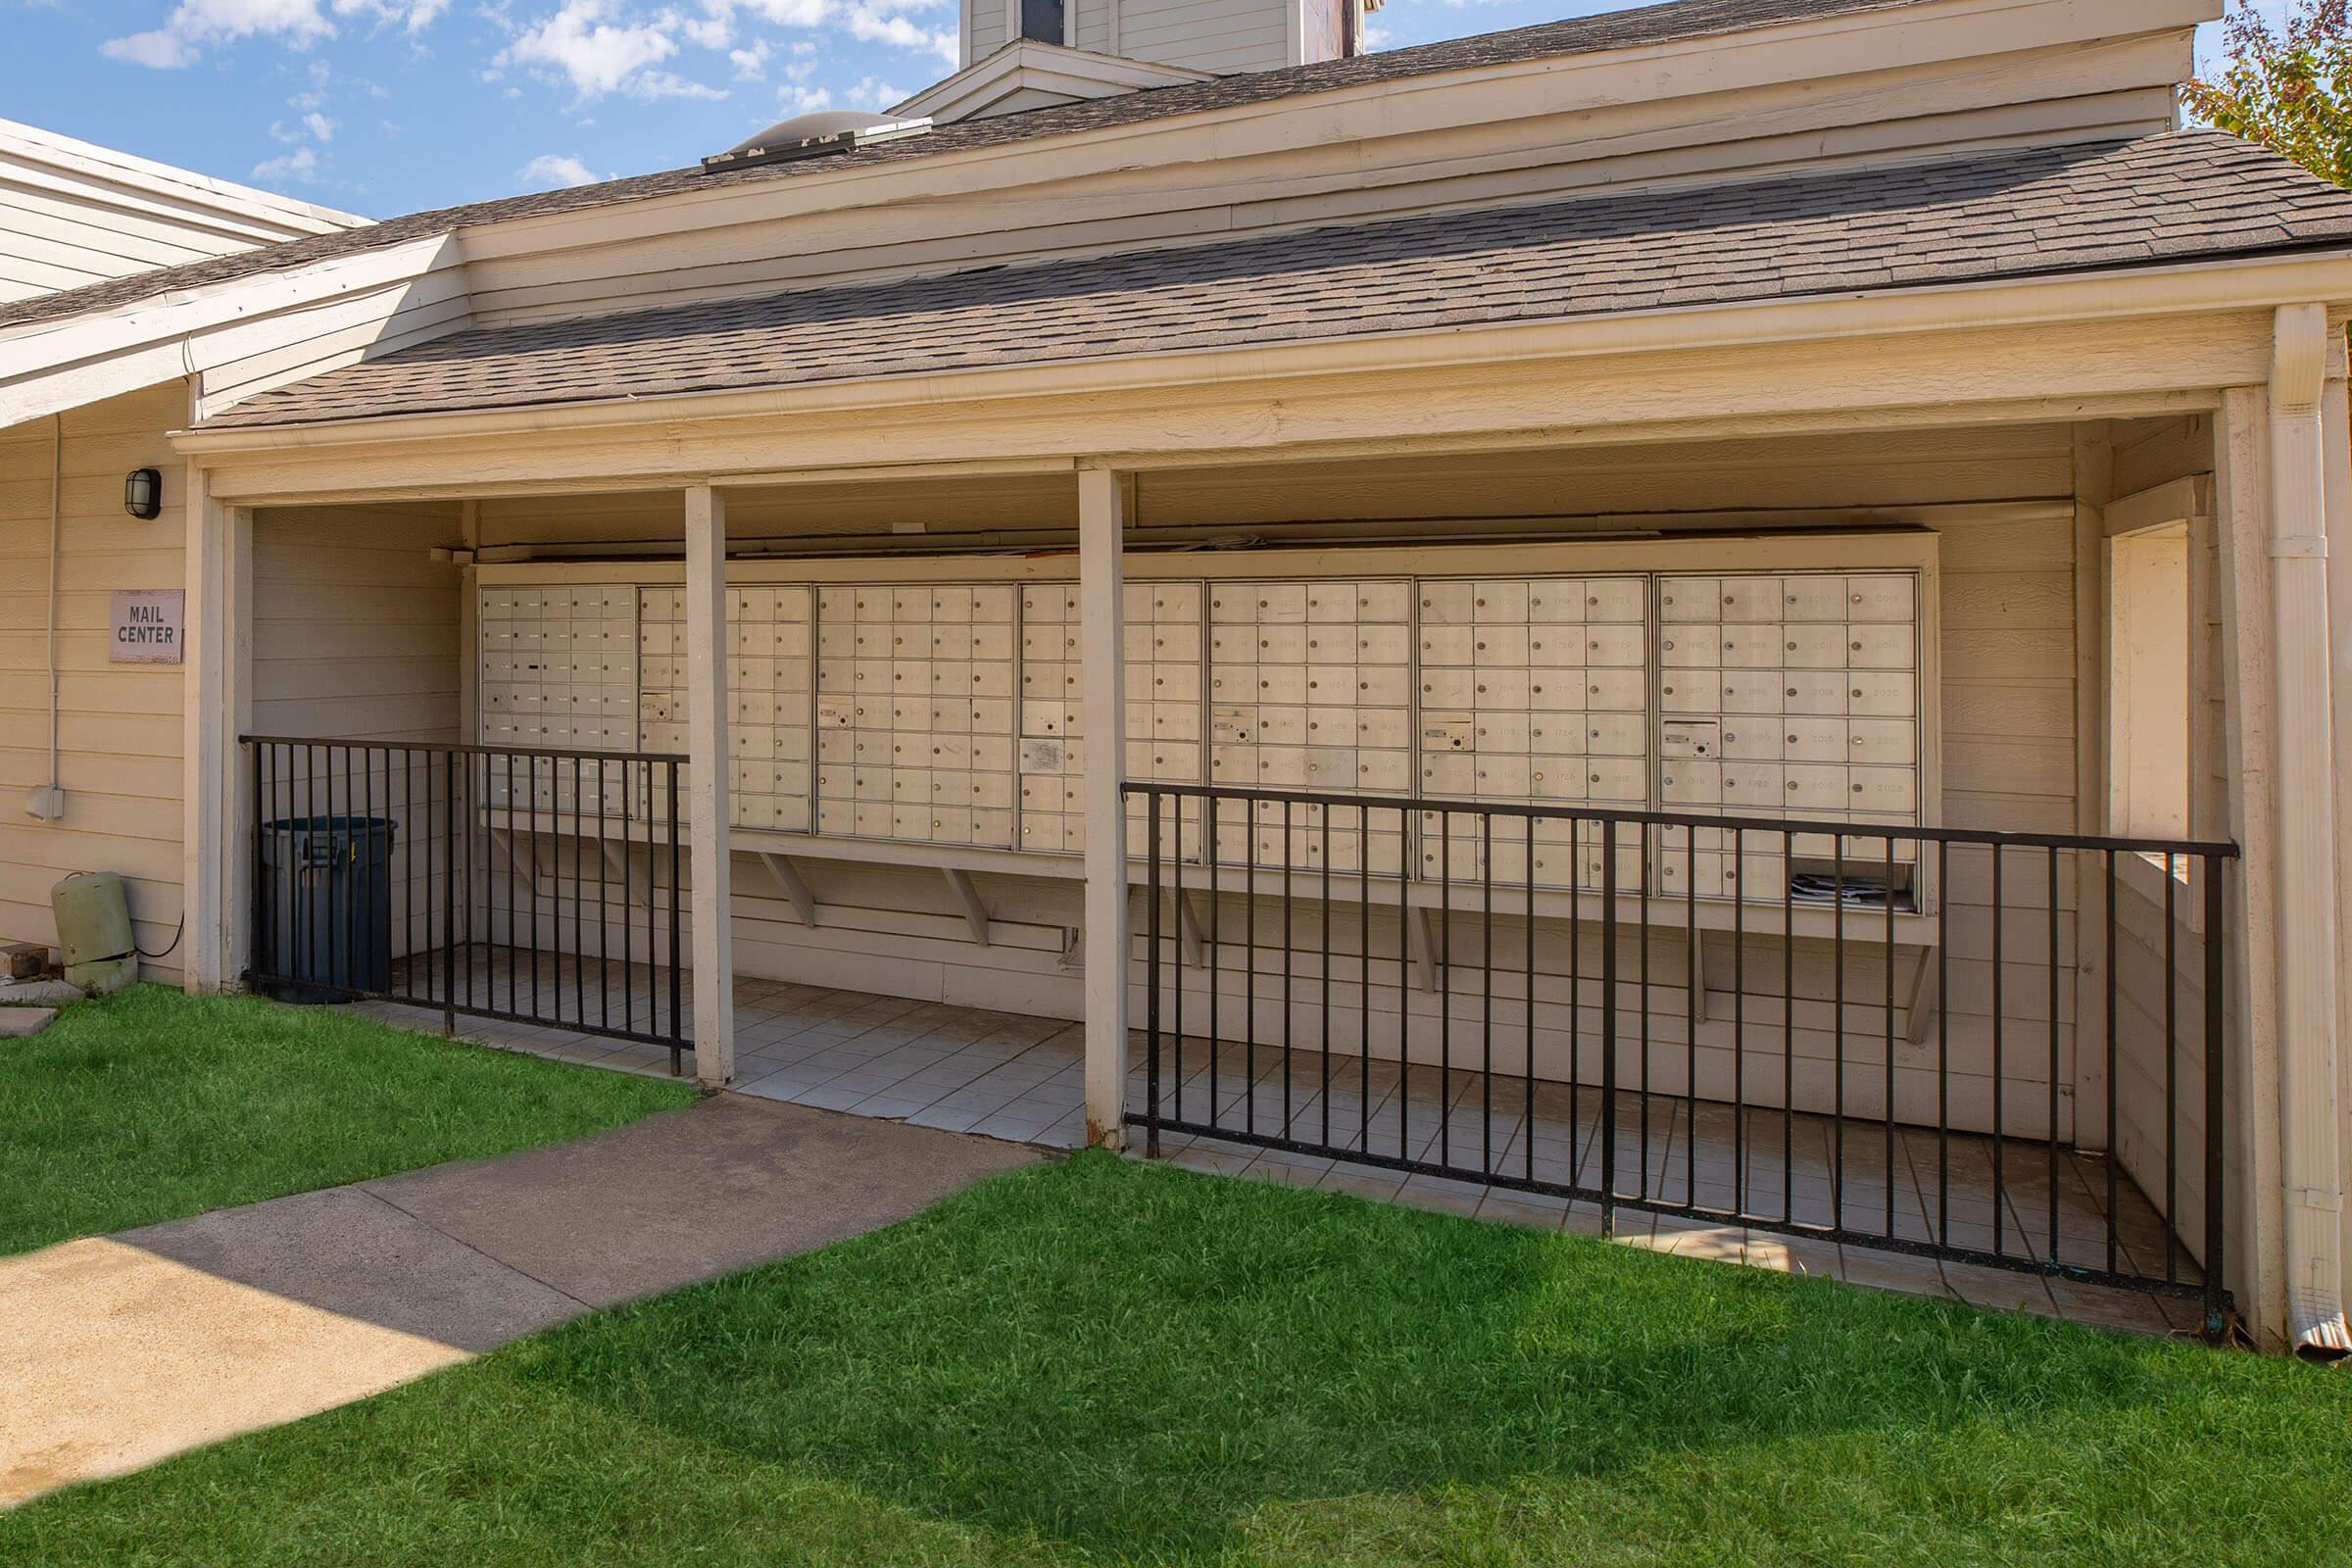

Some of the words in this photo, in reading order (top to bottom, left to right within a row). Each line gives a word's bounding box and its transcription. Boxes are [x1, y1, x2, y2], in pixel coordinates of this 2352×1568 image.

[129, 606, 165, 623] MAIL
[118, 626, 173, 644] CENTER
[1873, 689, 1899, 698] 2020
